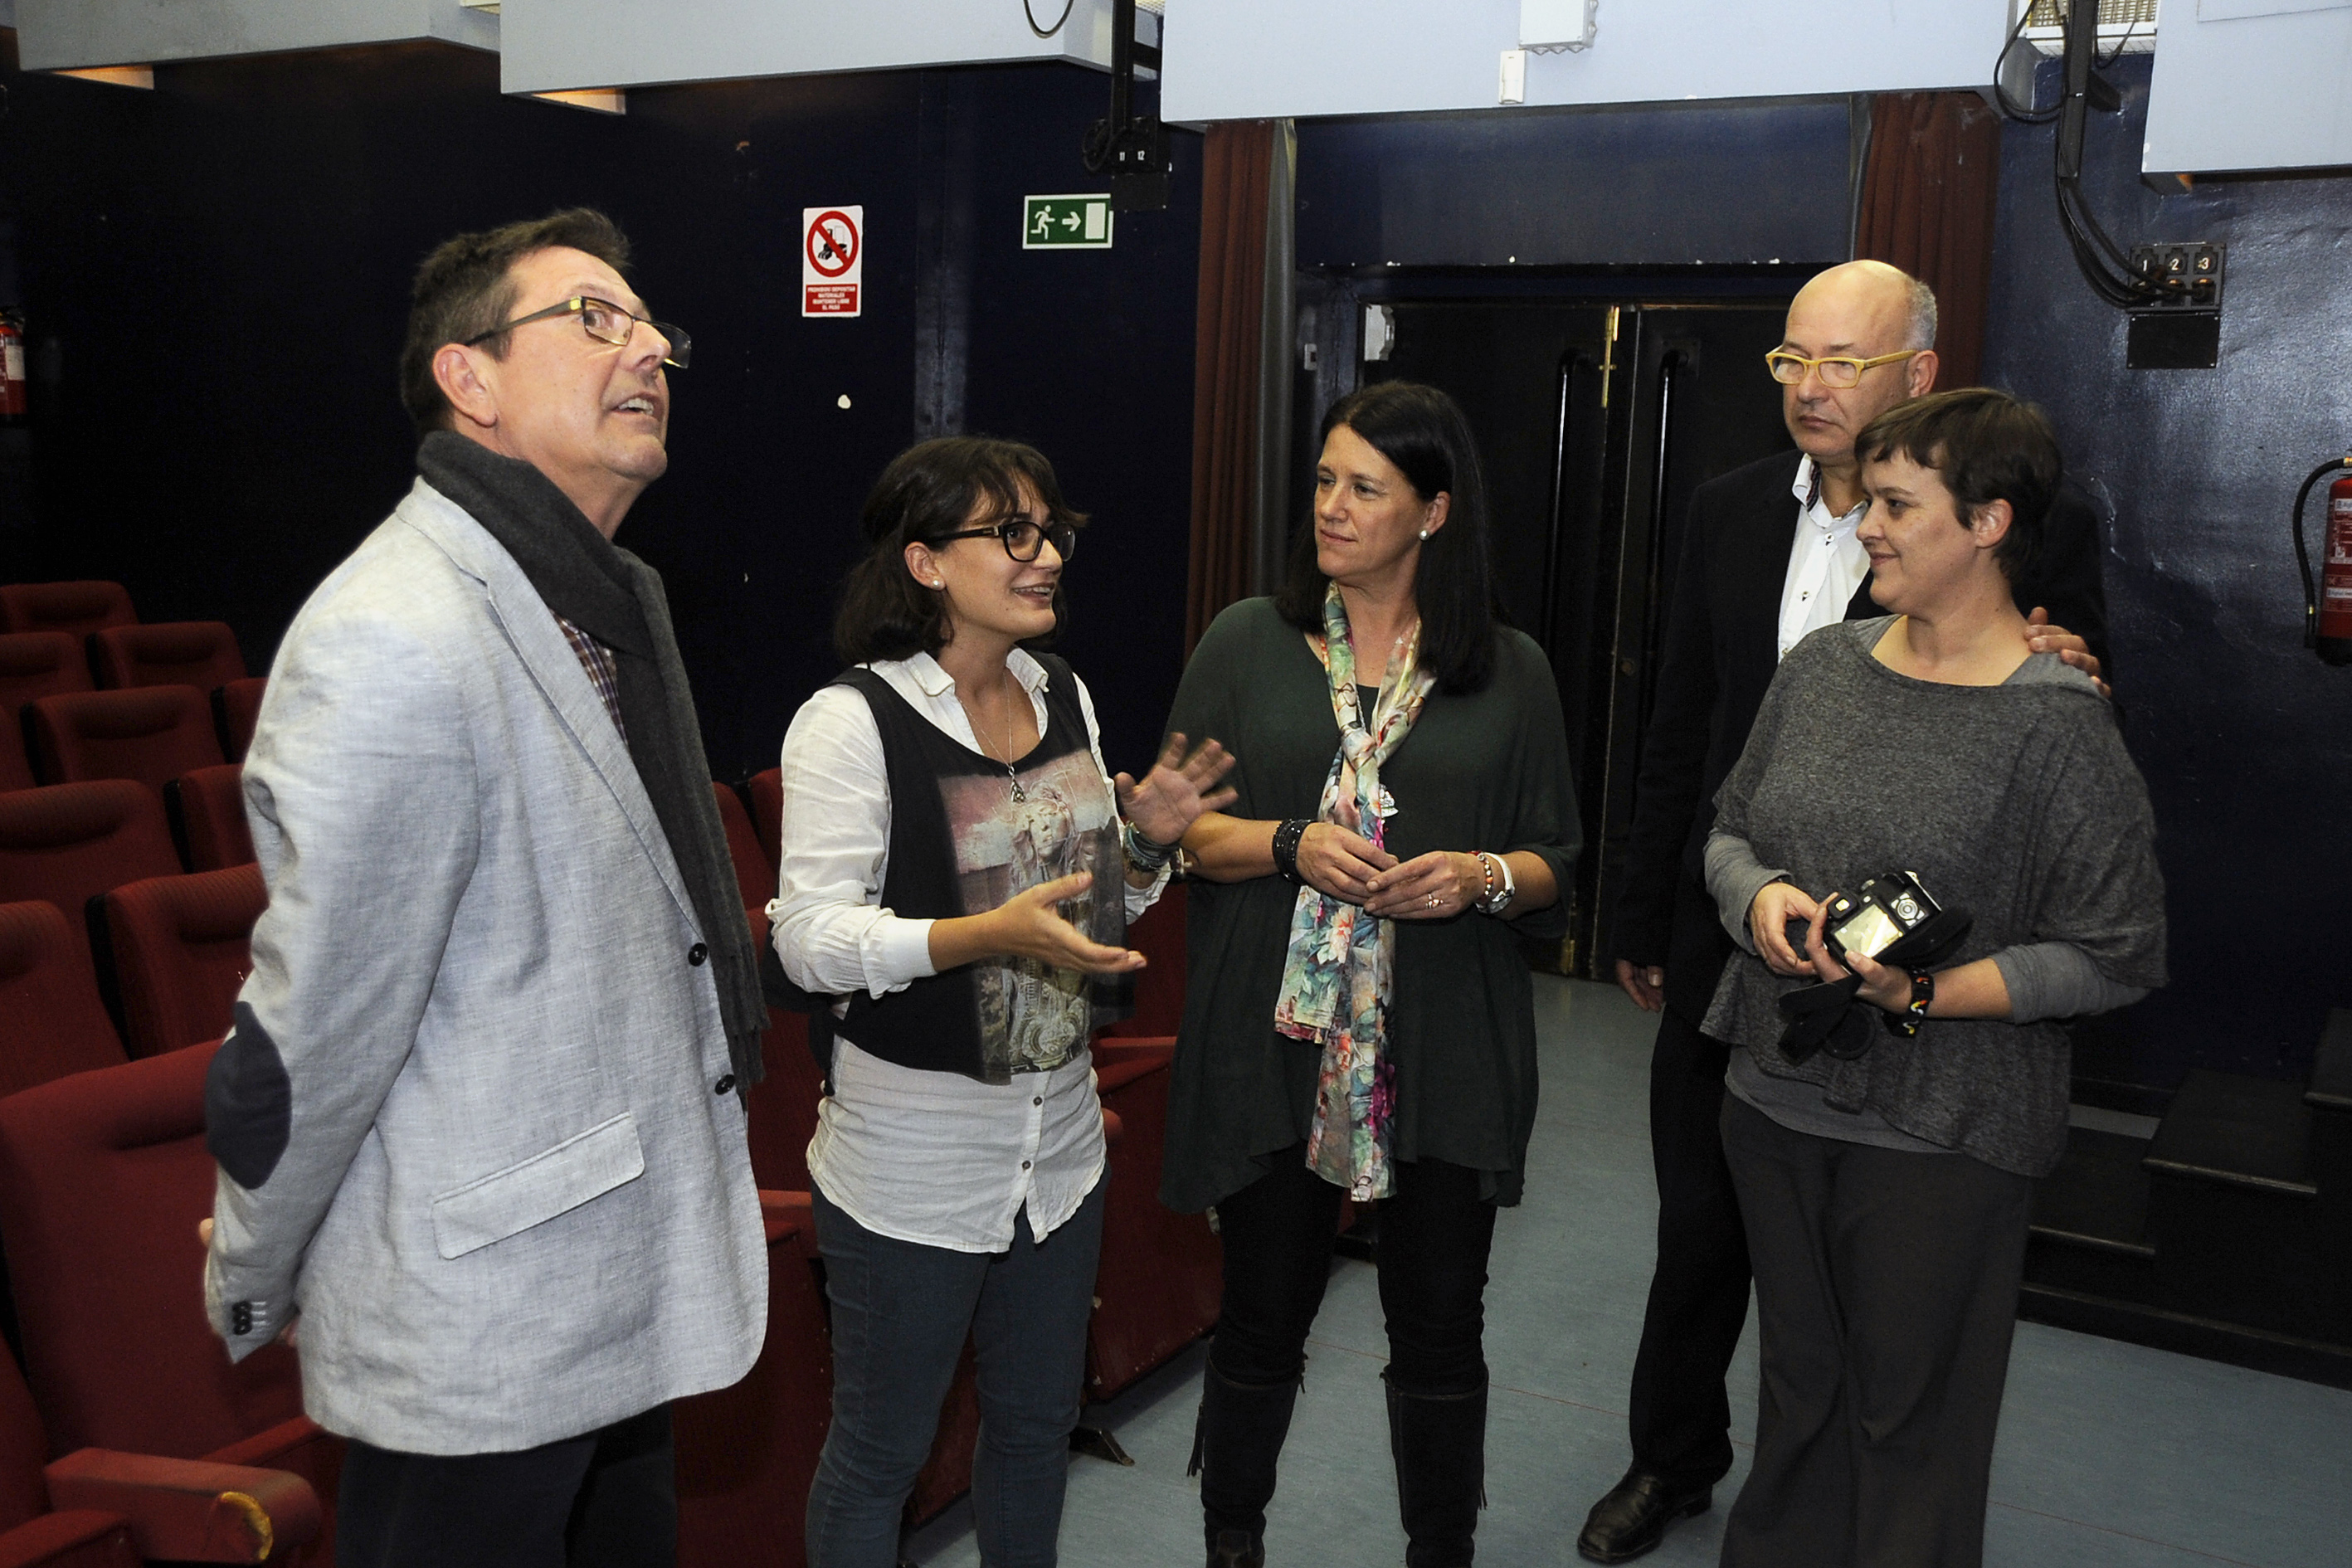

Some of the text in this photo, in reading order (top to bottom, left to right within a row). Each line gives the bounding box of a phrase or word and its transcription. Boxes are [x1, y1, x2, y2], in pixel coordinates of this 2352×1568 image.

[1137, 150, 1145, 161] 12
[2143, 257, 2209, 271] 1 2 3
